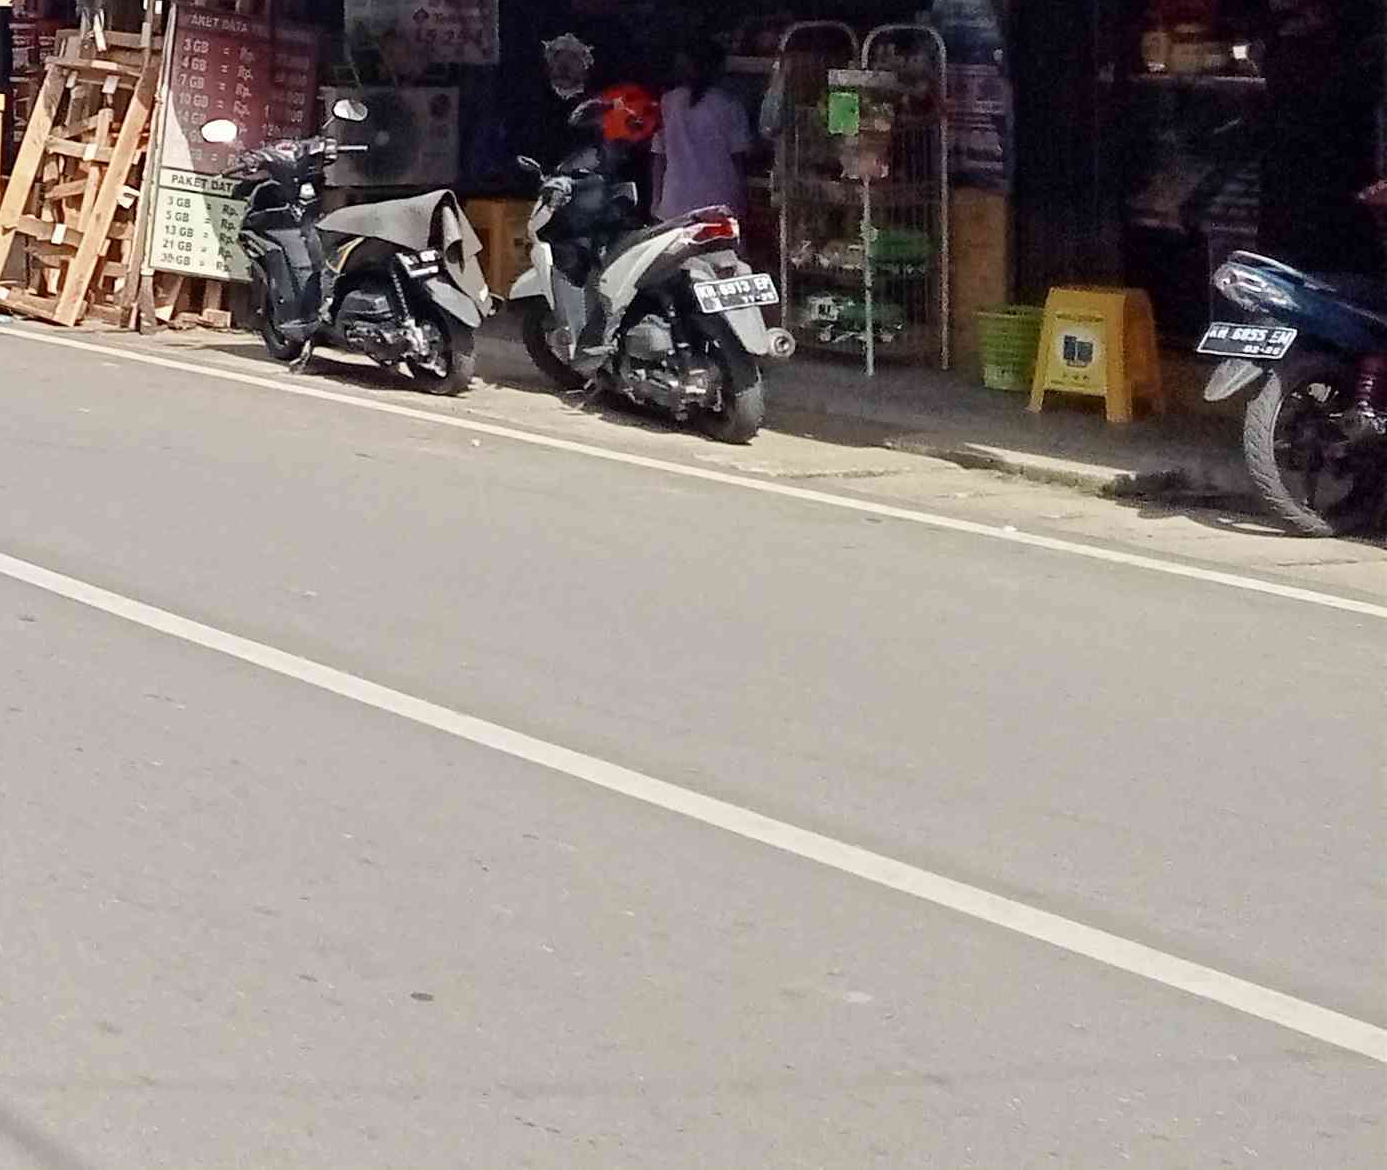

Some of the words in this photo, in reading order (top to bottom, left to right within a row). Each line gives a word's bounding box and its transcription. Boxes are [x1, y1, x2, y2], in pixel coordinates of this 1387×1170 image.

[171, 174, 207, 189] PAKET
[210, 180, 234, 191] DAT
[176, 198, 191, 208] GB
[174, 212, 189, 223] GB
[179, 226, 194, 238] GB
[177, 241, 192, 252] GB
[176, 255, 191, 266] GB
